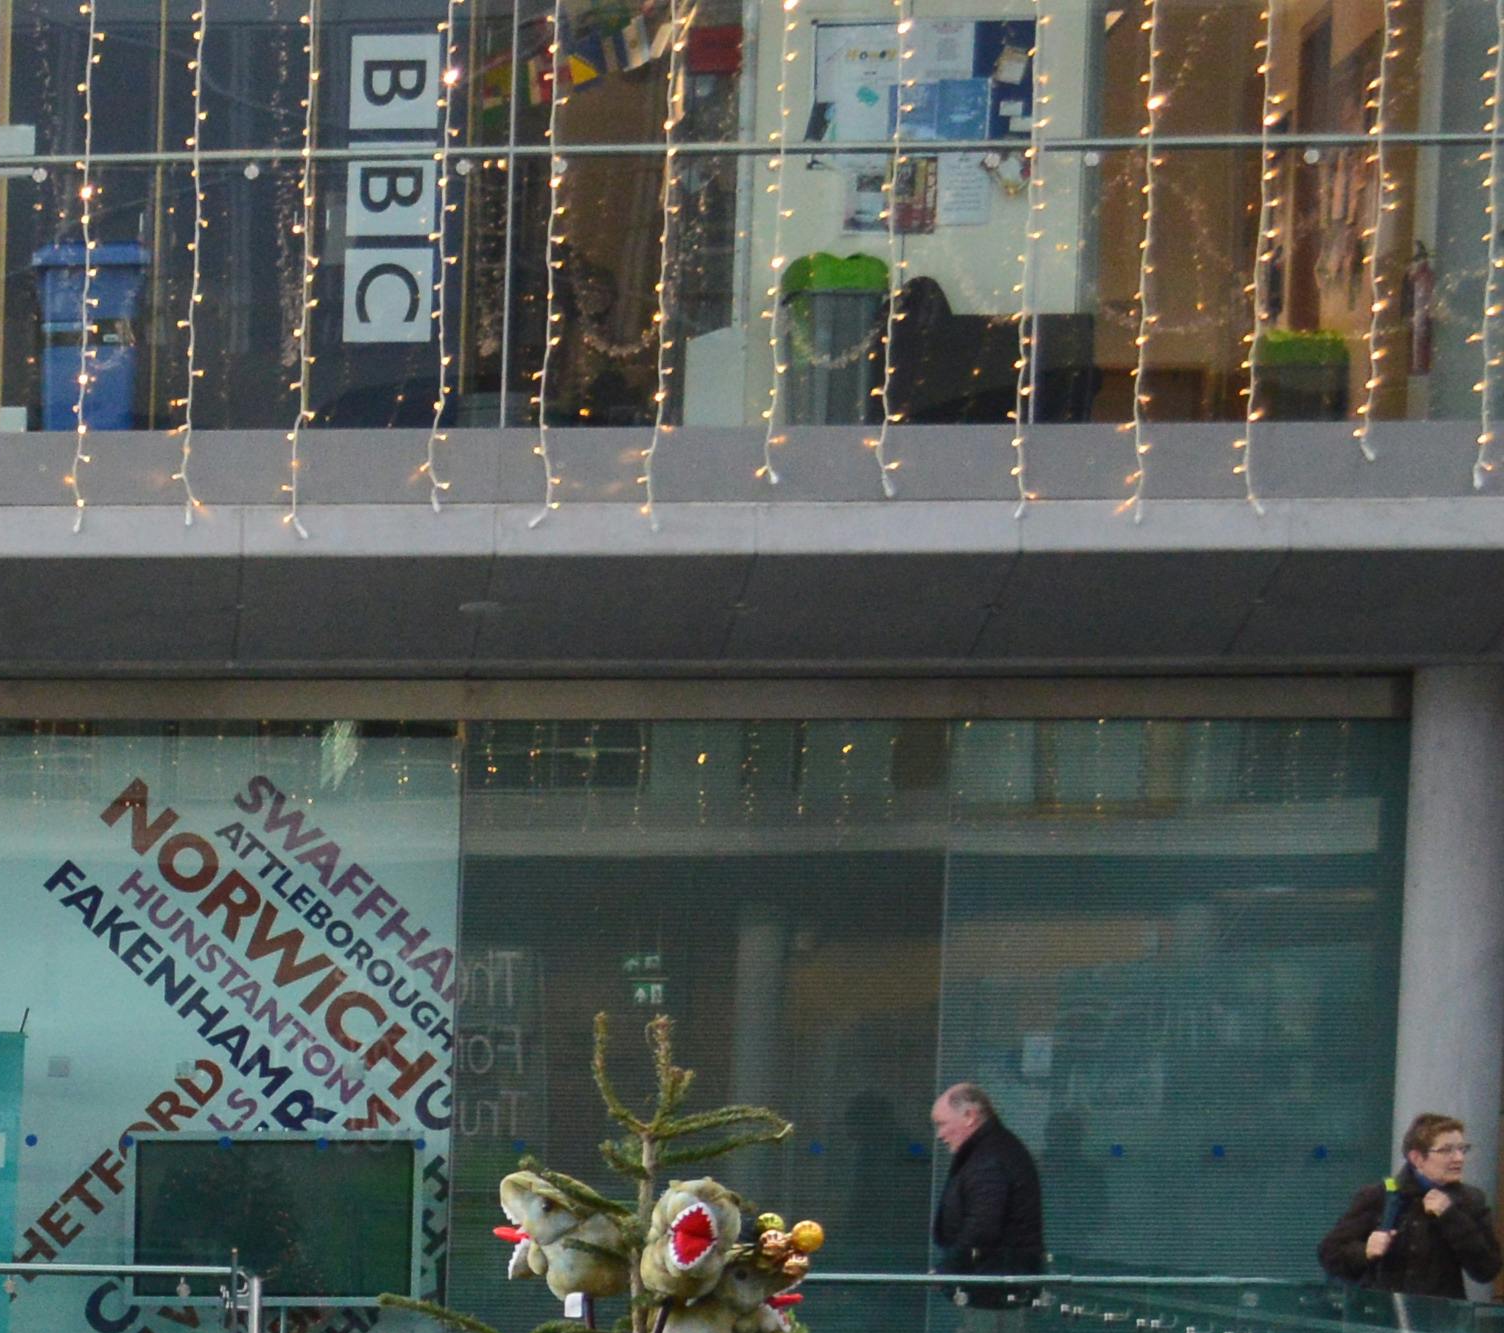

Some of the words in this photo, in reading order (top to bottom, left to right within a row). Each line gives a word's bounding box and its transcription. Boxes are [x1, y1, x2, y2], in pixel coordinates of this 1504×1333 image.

[346, 40, 436, 338] BBC
[43, 859, 293, 1098] FAKENHAM
[100, 777, 437, 1099] NORWICH
[118, 869, 365, 1104] HUNSTANTON
[215, 822, 454, 1052] ATTLEBOROUGH
[235, 775, 455, 1002] SWAFFHA
[12, 1059, 224, 1290] HETFORD
